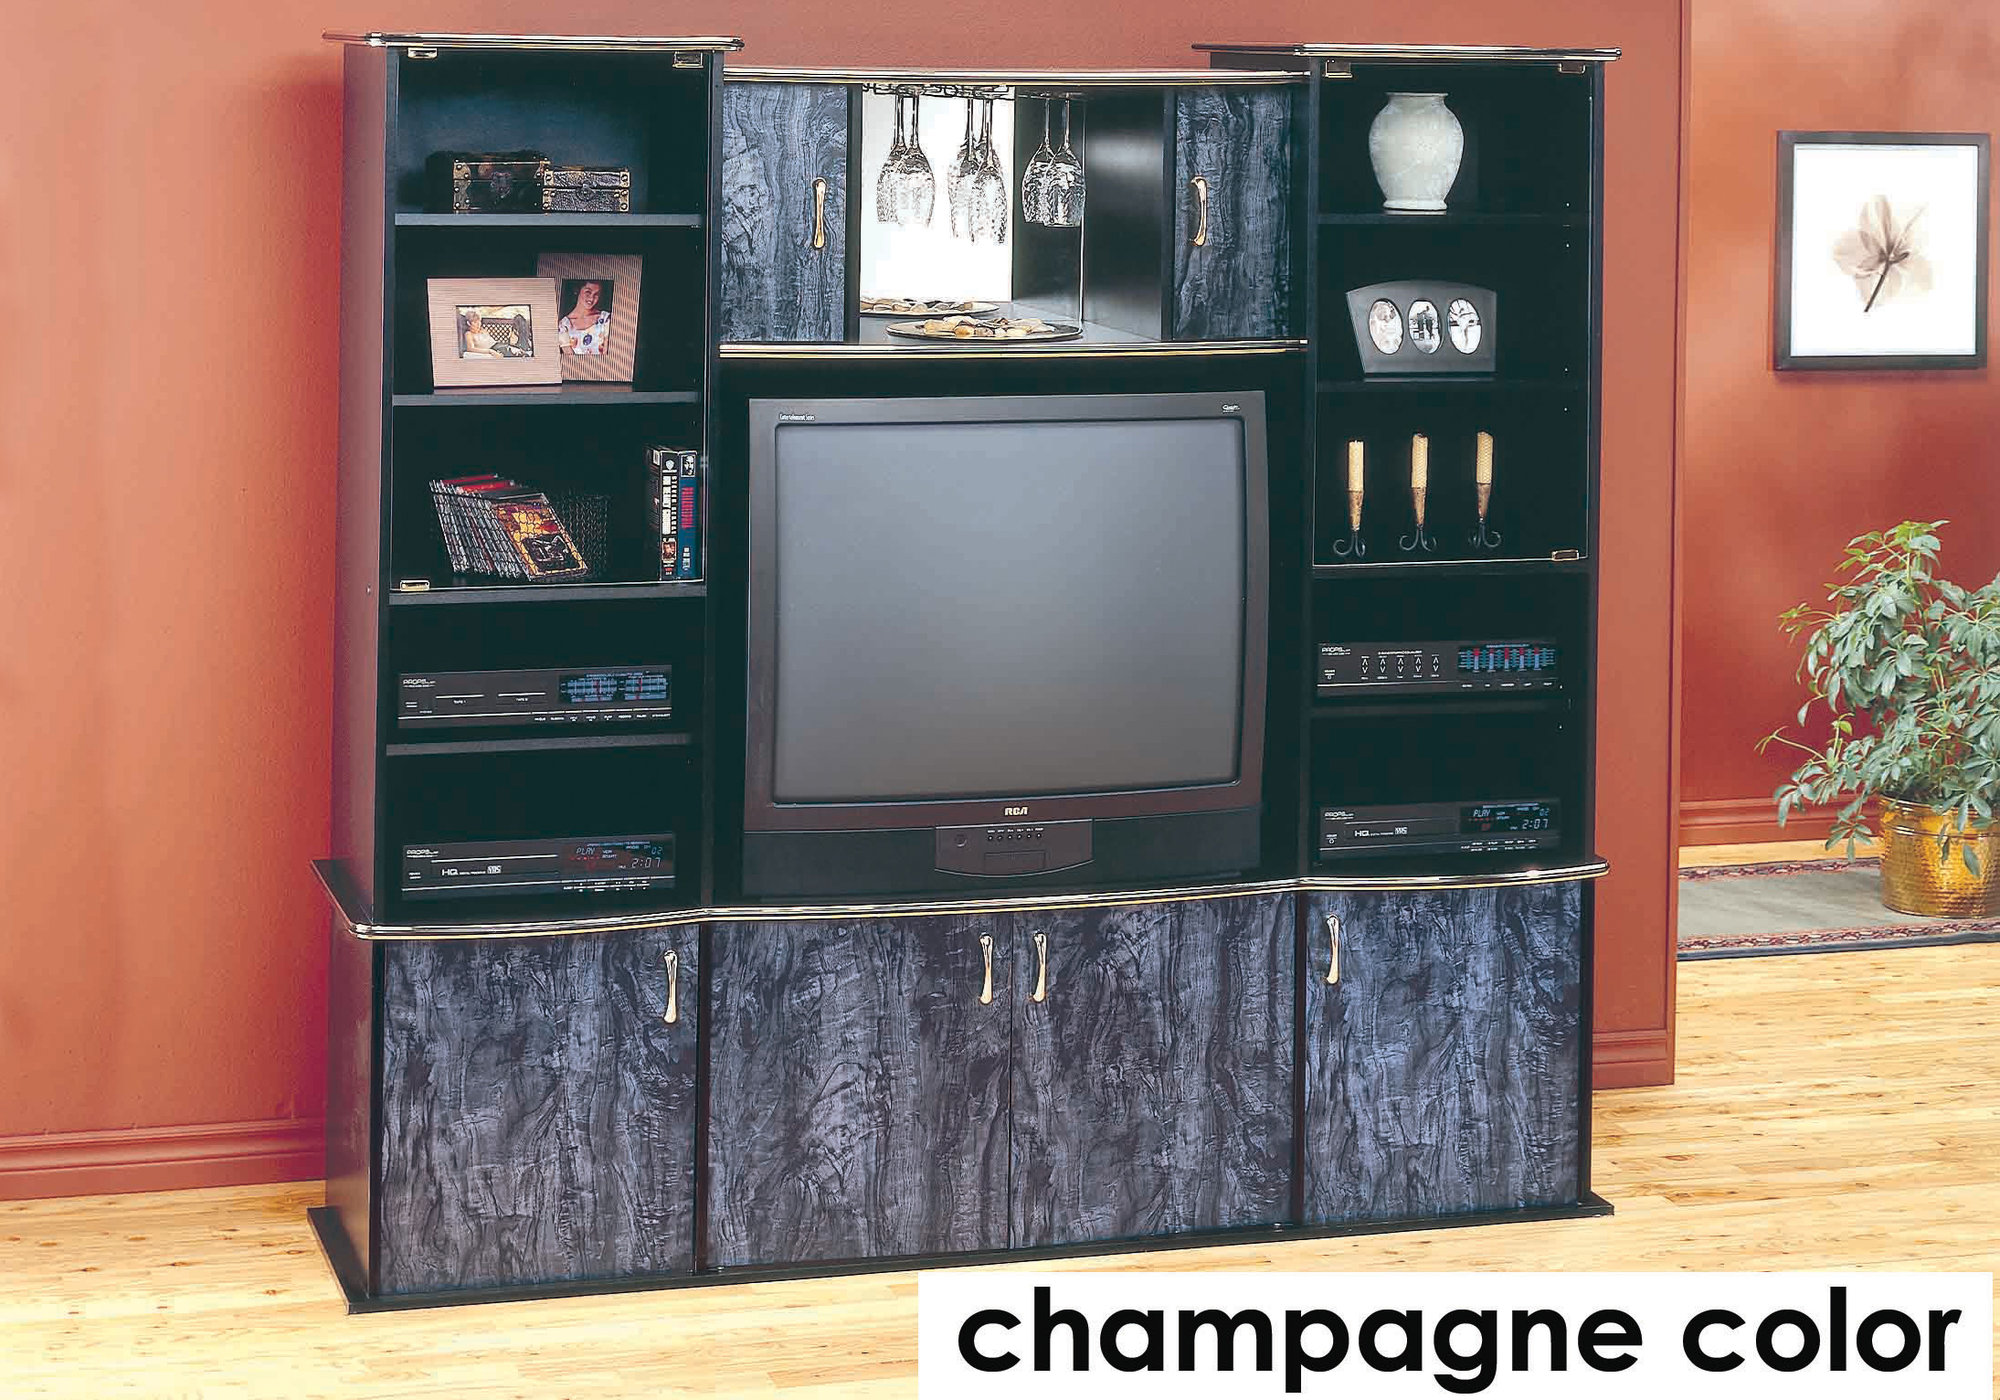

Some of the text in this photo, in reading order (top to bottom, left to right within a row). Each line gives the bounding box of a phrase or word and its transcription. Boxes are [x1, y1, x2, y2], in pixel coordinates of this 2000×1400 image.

[1004, 806, 1028, 816] RCA
[1473, 809, 1491, 817] PLAY
[1522, 818, 1549, 830] 2:07
[576, 847, 596, 855] PLAY
[631, 857, 661, 869] 2:07
[441, 868, 459, 876] HQ
